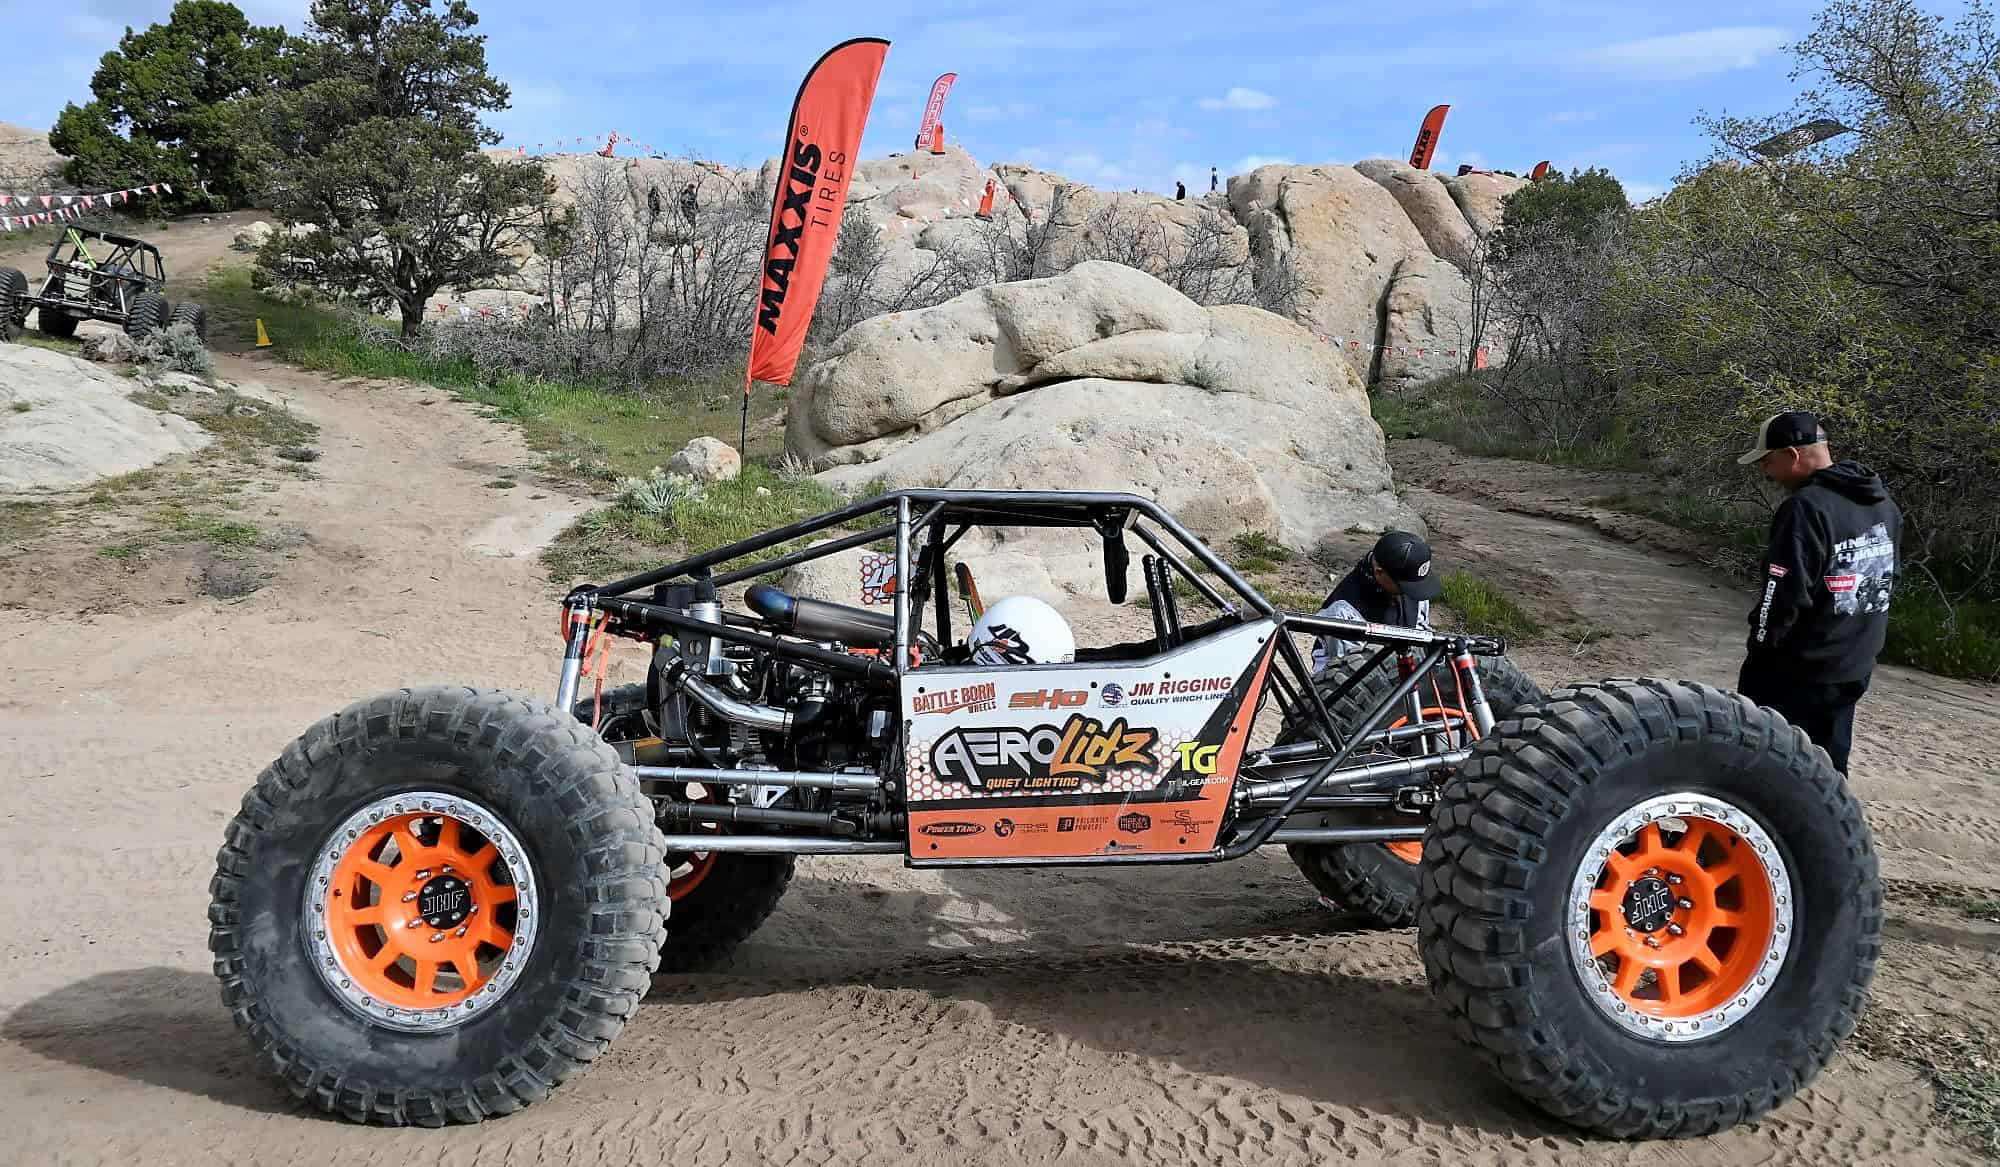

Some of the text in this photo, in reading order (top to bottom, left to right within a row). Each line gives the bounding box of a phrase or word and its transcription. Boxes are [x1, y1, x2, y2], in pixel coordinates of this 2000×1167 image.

[811, 151, 846, 231] TIRES
[1128, 676, 1232, 697] JM RIGGING
[912, 682, 995, 713] BATTLE BORN
[1130, 697, 1169, 706] QUALITY
[1172, 694, 1202, 704] WINCH
[1205, 691, 1232, 701] LINES
[968, 701, 997, 714] WHEELS
[1174, 741, 1221, 774] TG
[986, 776, 1079, 789] QUIET LIGHTING
[1168, 776, 1229, 787] TIL-GEAR.COM
